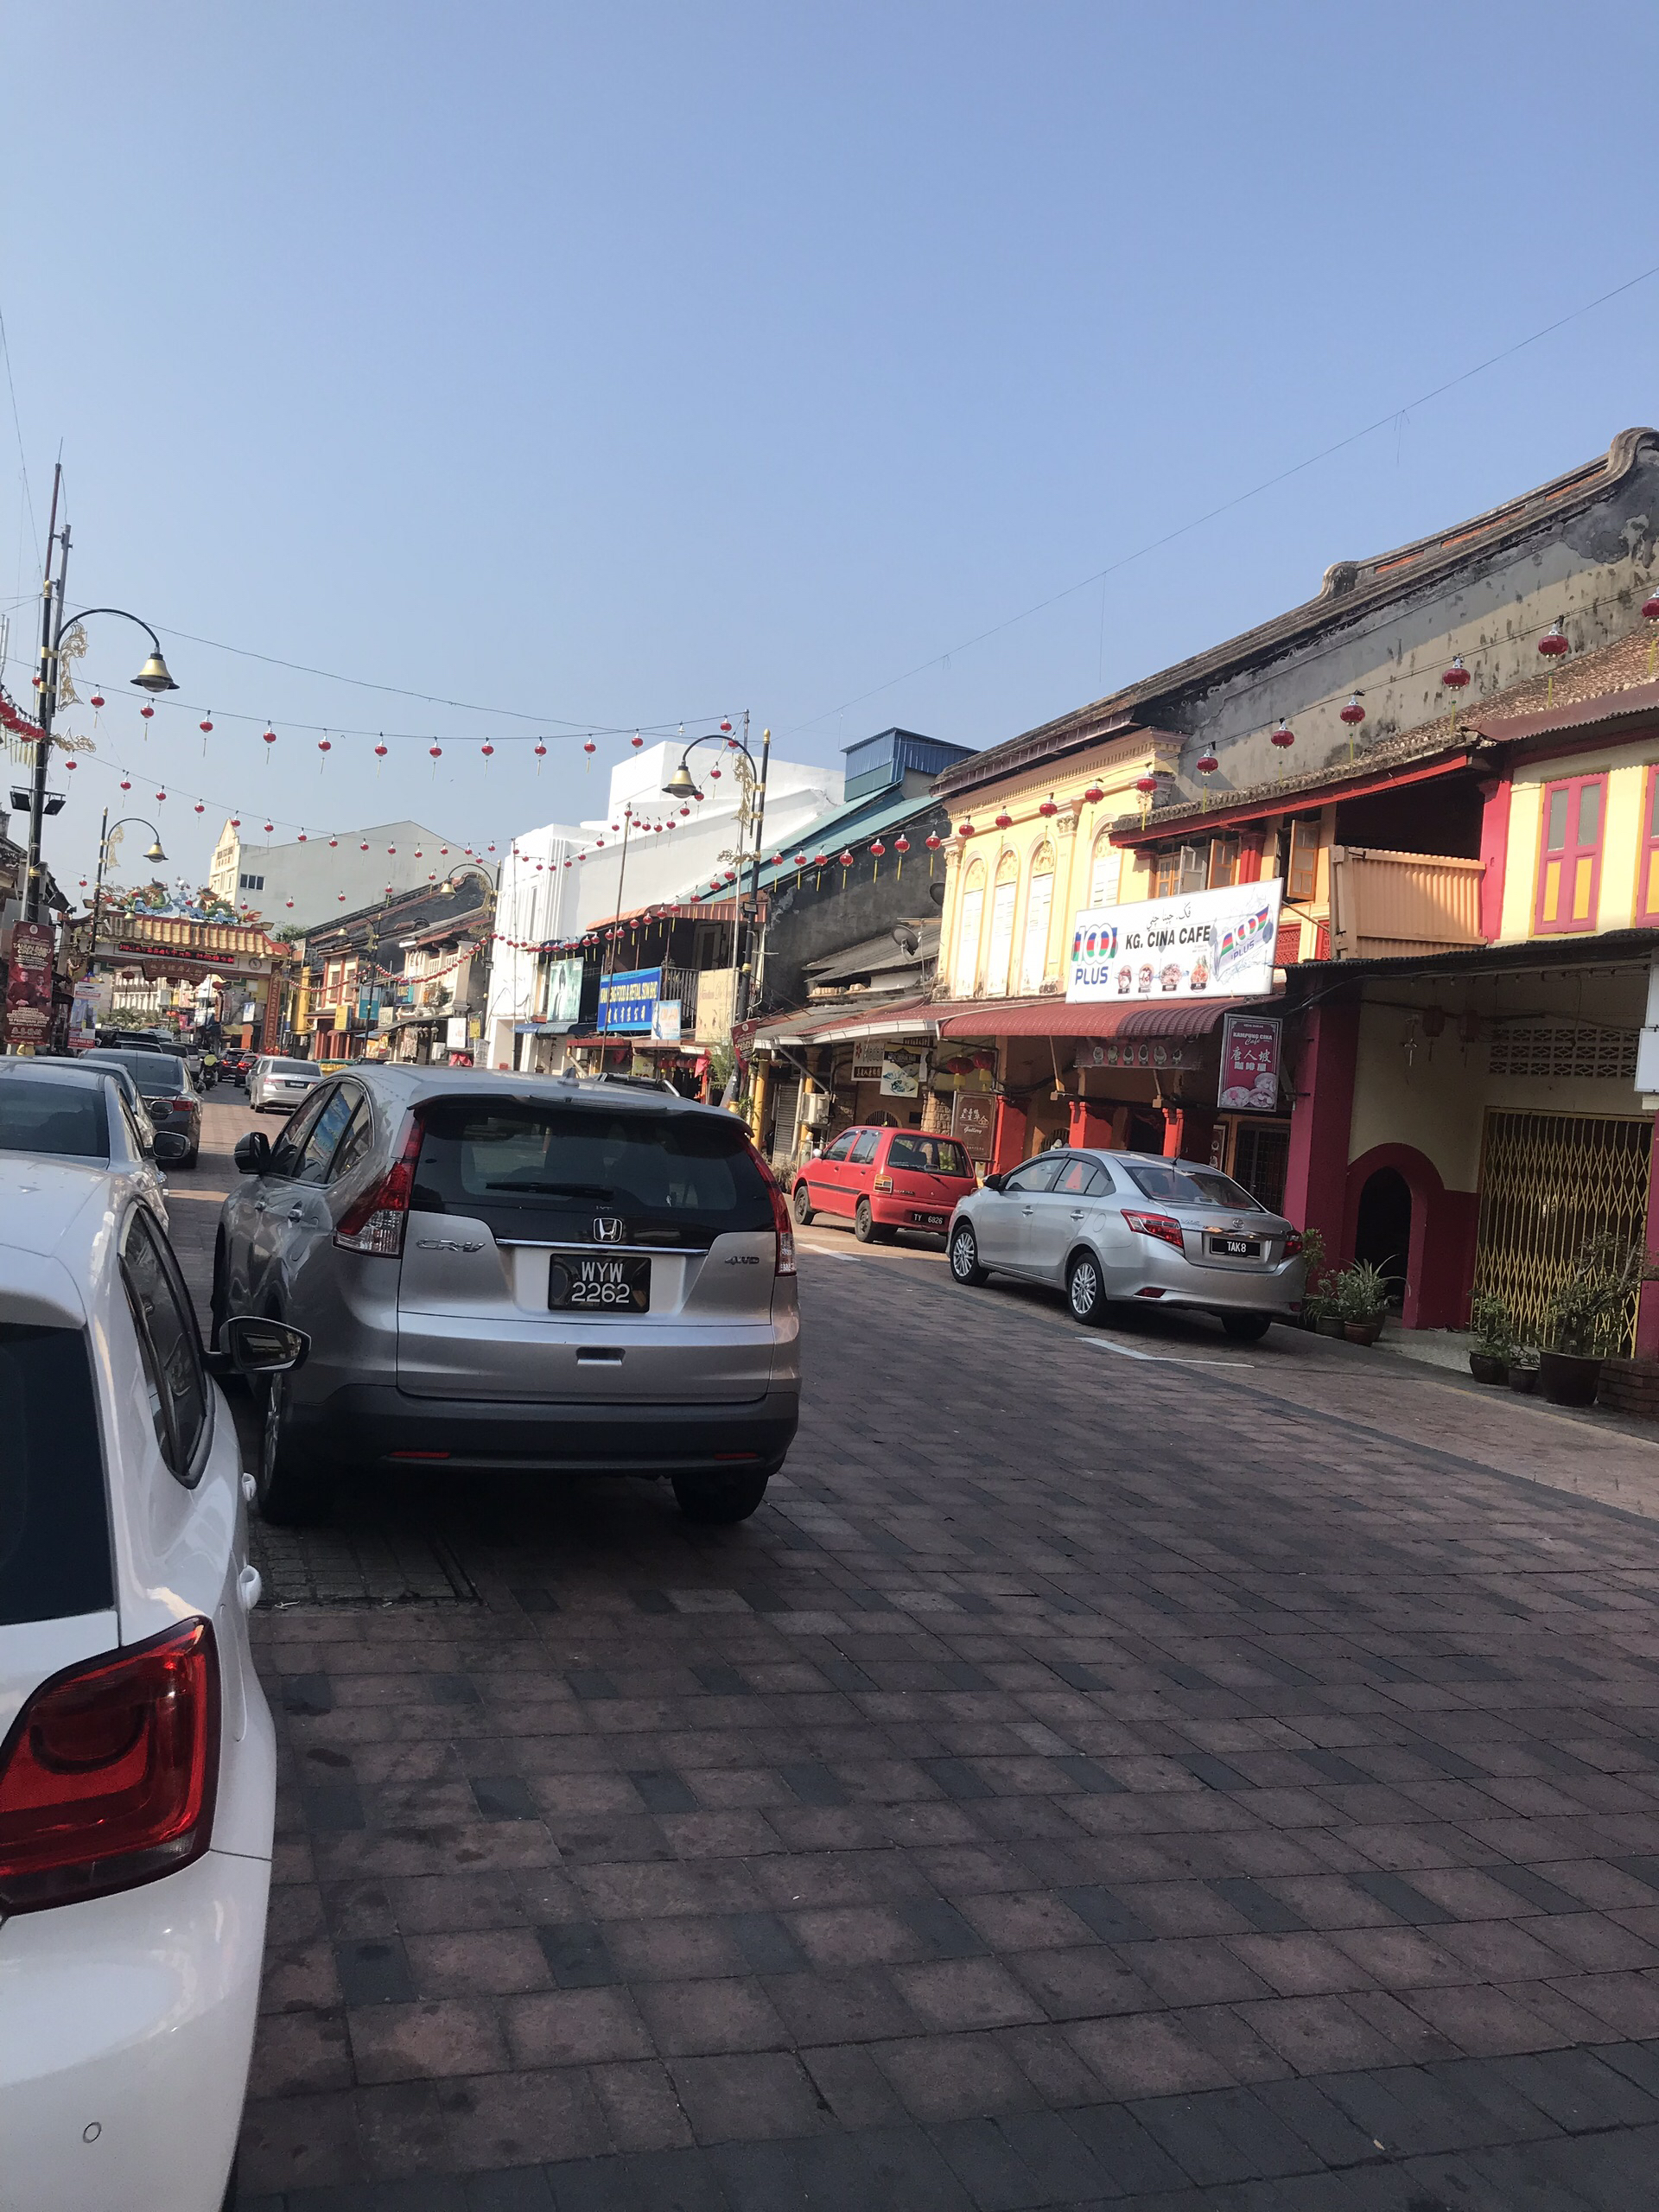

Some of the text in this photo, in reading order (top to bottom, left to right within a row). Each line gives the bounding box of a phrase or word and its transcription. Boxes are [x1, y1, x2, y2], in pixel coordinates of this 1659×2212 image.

[1077, 923, 1114, 966] 100
[1125, 925, 1211, 950] KG. CINA CAFE
[1233, 940, 1255, 960] PLUS
[1075, 966, 1109, 986] PLUS
[1230, 1046, 1271, 1063] 唐人坡
[914, 1213, 944, 1224] TY 6826
[582, 1261, 623, 1283] WYW
[571, 1281, 630, 1304] 2262
